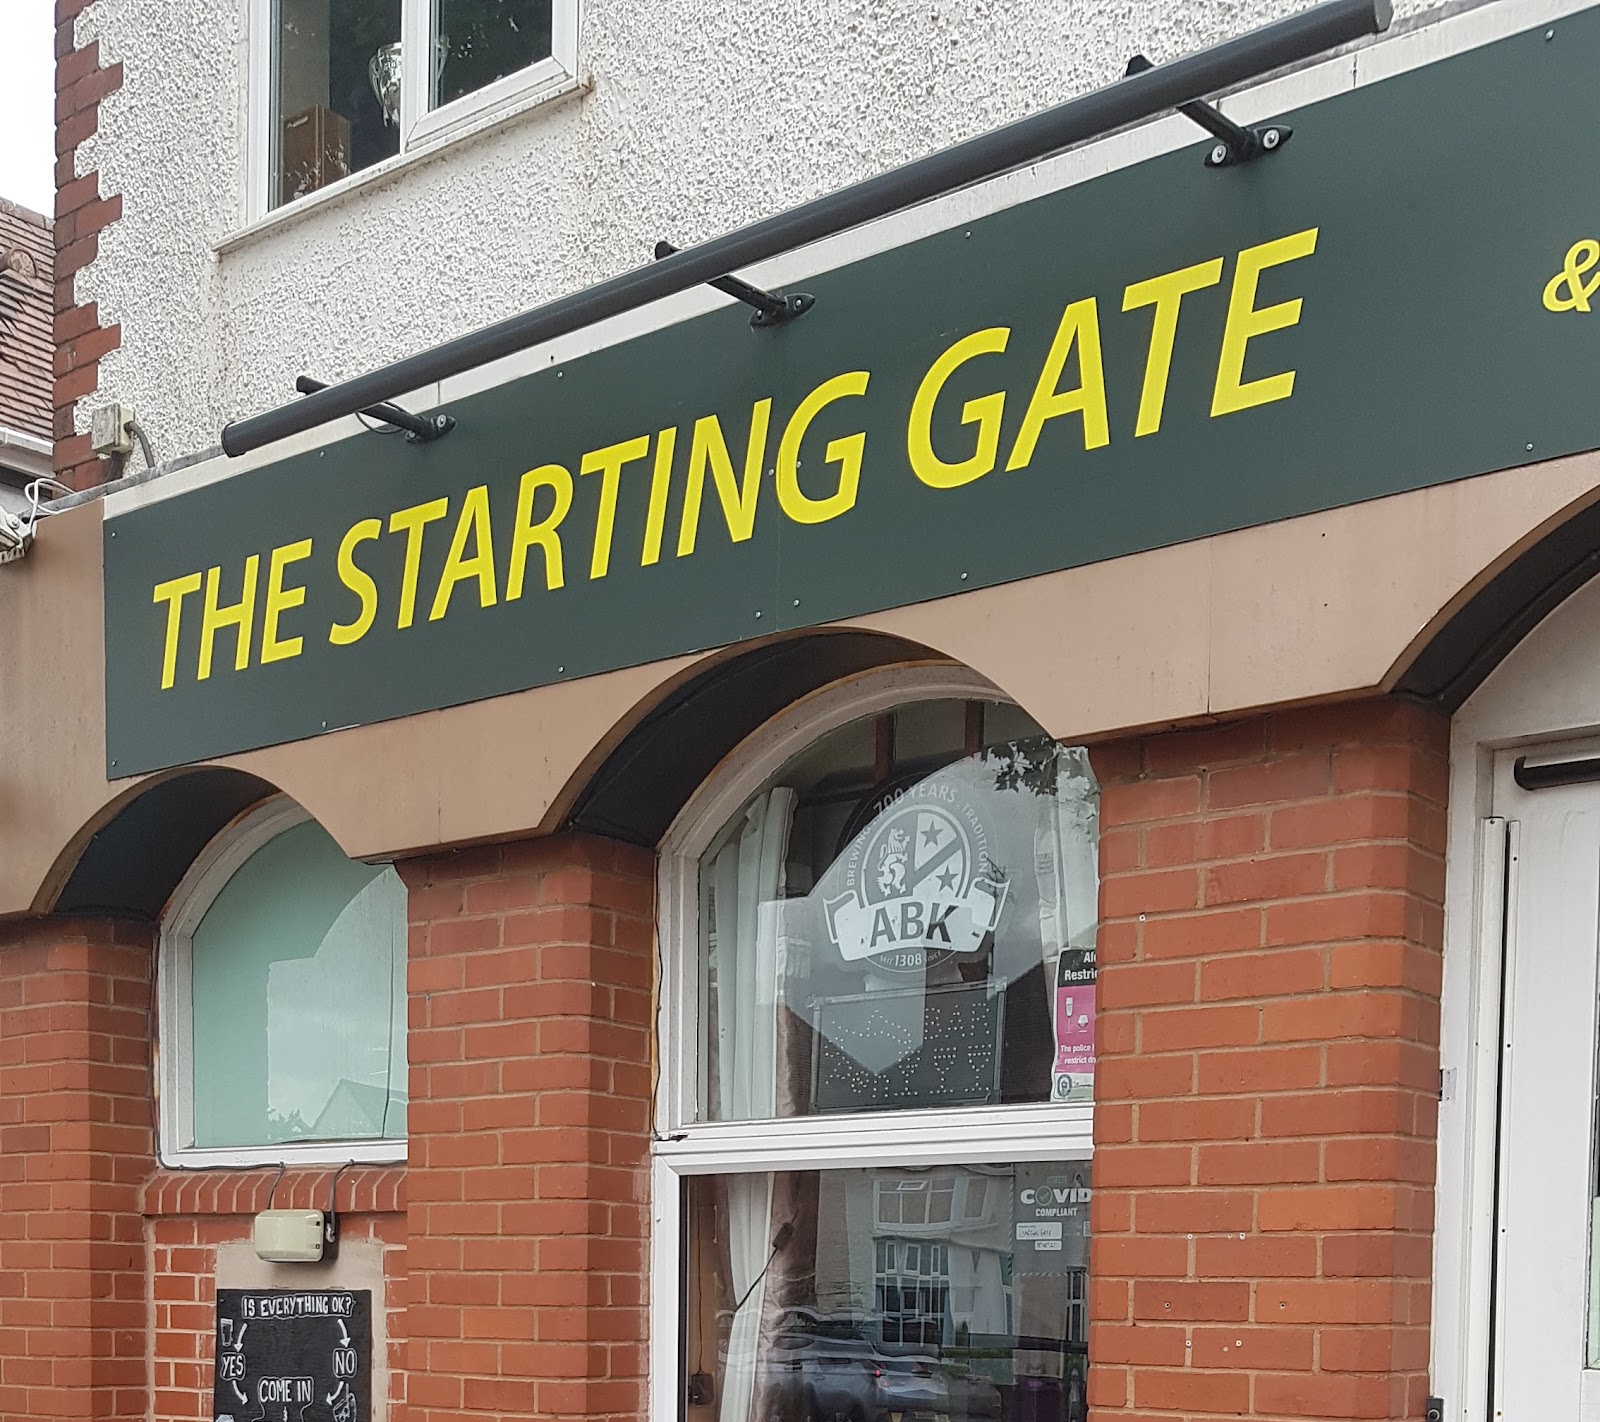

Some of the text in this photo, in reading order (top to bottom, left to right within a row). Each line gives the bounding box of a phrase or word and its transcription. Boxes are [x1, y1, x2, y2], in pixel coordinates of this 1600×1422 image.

[1542, 238, 1600, 313] &
[152, 227, 1319, 692] THE STARTING GATE
[846, 825, 872, 886] BREWING
[910, 783, 958, 803] YEARS
[961, 804, 988, 873] TRADITION
[870, 901, 960, 948] ABK
[895, 953, 922, 967] 1308
[1072, 1044, 1091, 1053] police
[1035, 1207, 1078, 1217] COMPLIANT
[244, 1296, 352, 1316] IS EVERYTHING OK?
[222, 1350, 355, 1377] YES NO
[260, 1379, 311, 1402] COME IN
